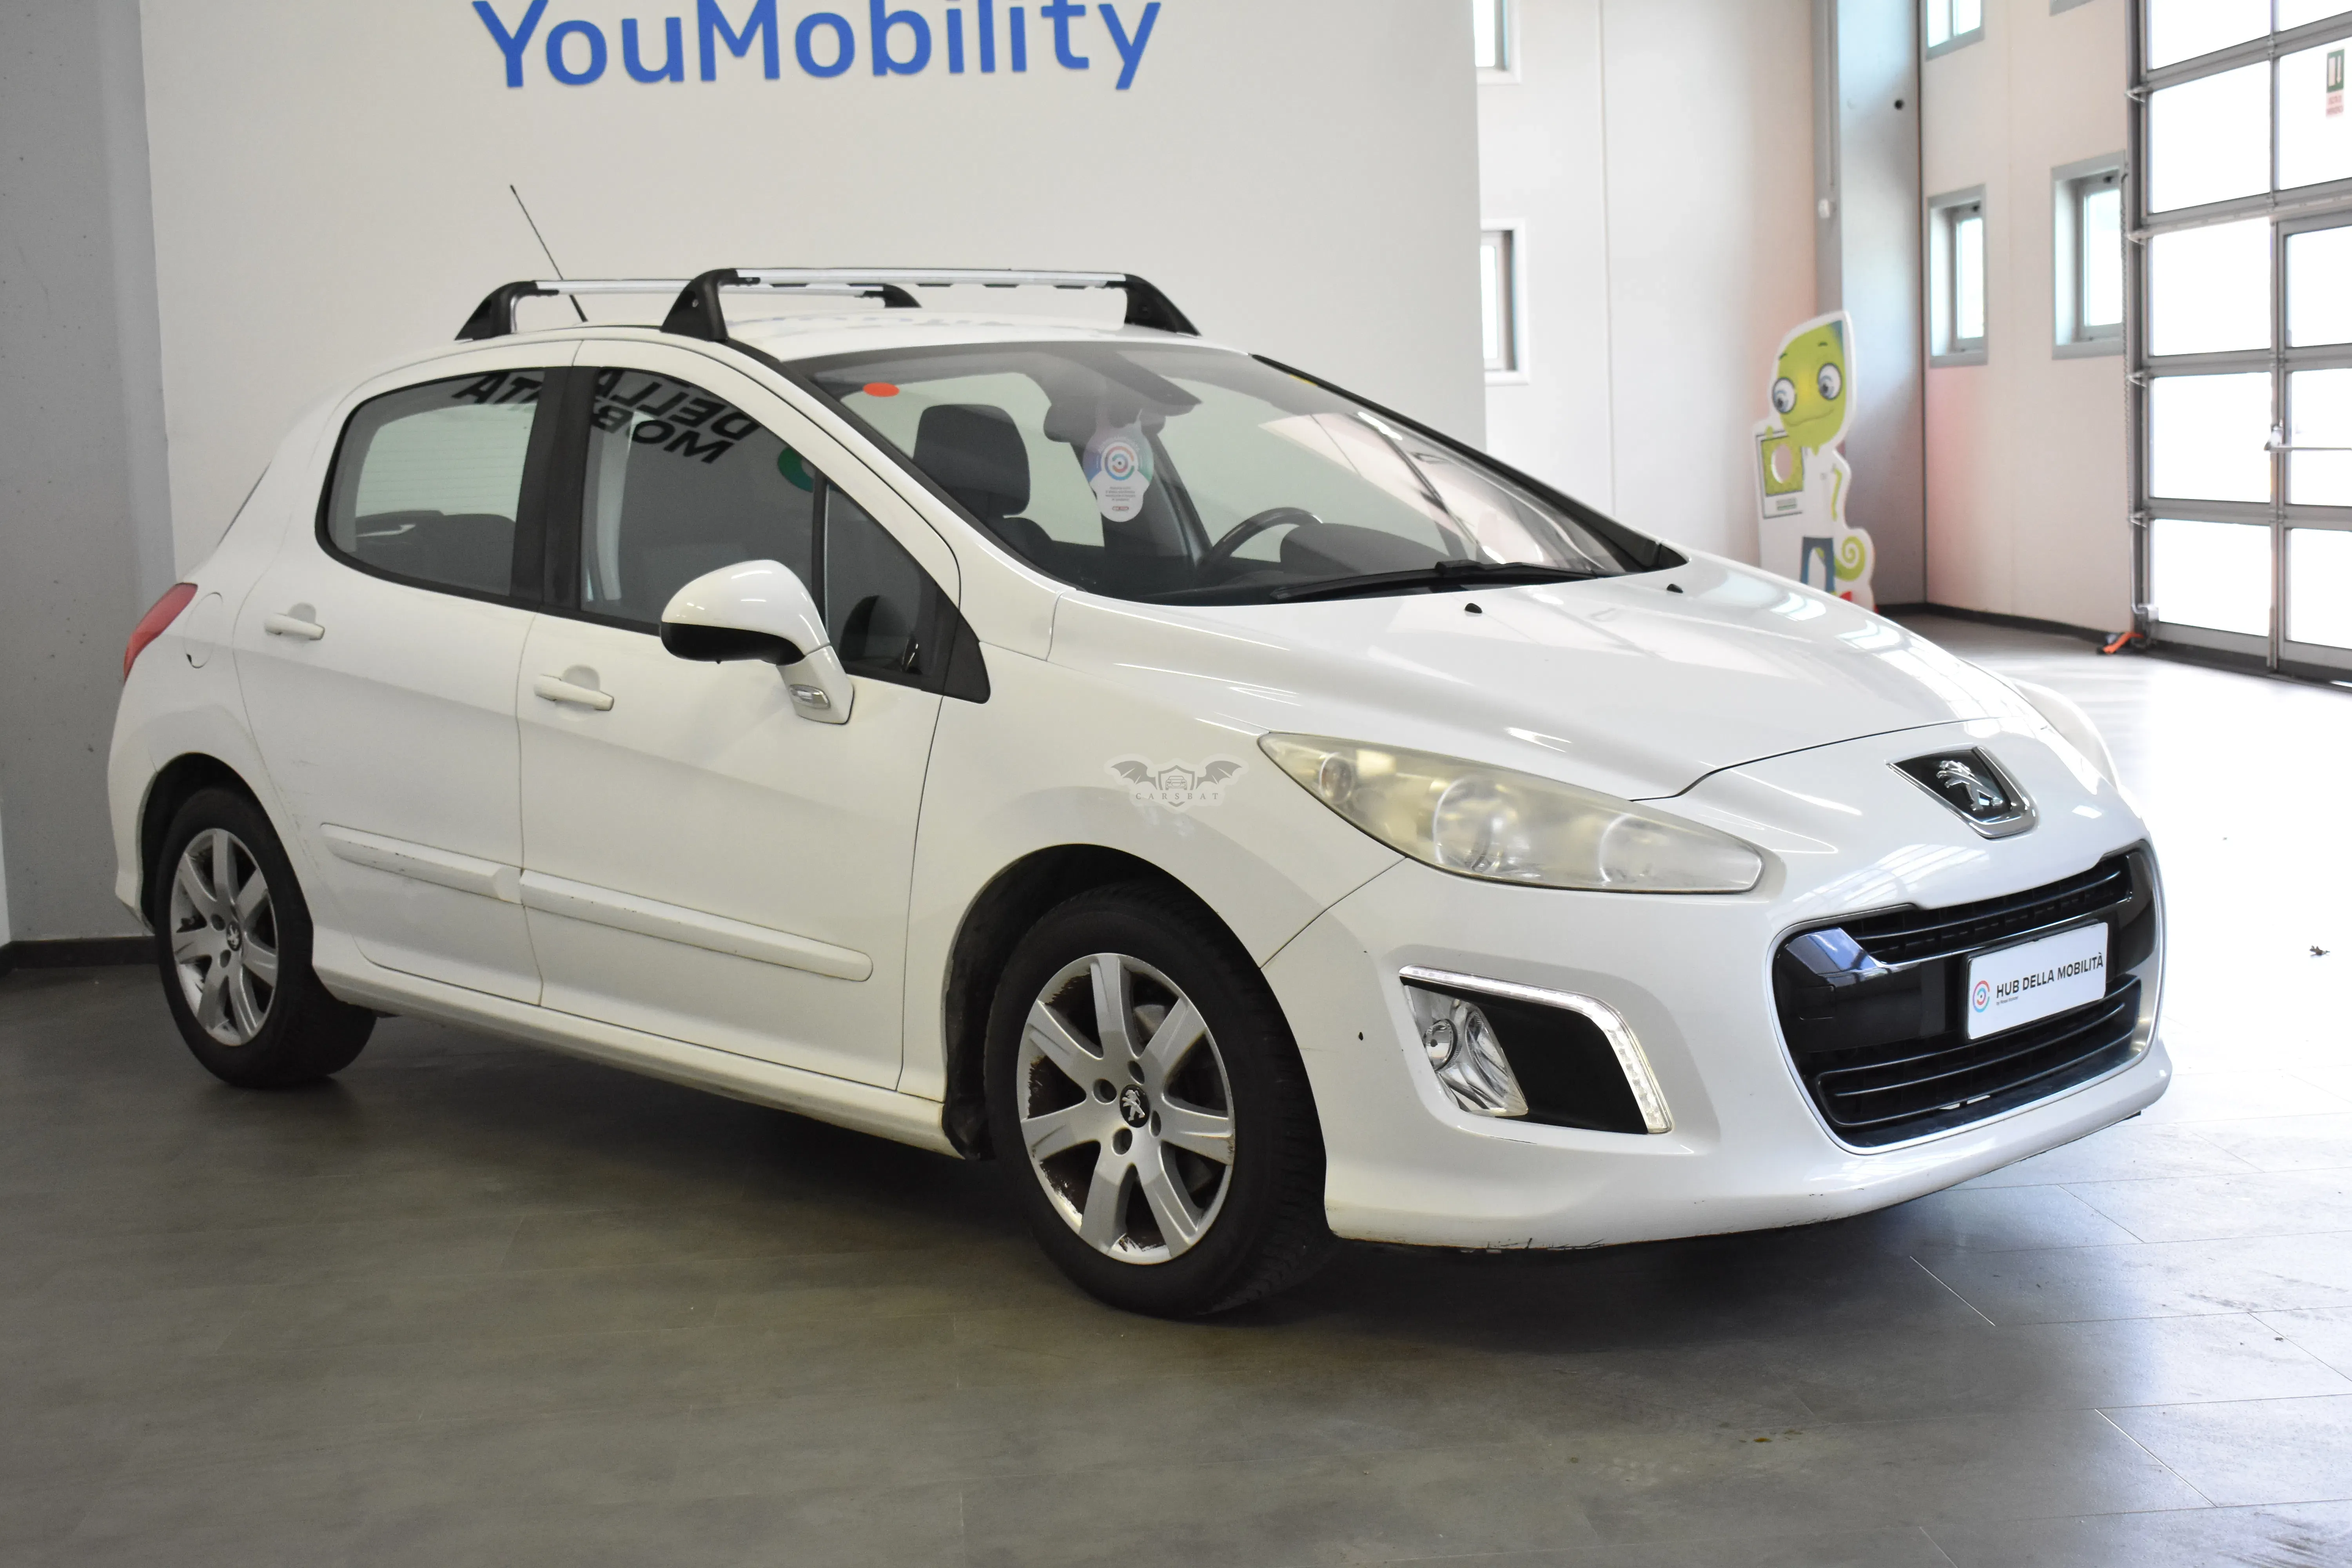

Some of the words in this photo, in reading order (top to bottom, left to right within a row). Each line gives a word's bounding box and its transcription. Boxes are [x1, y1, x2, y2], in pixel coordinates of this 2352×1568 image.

[473, 0, 1161, 90] YouMobility
[1996, 980, 2020, 998] HUB
[2023, 970, 2054, 991] DELLA
[2057, 952, 2103, 980] MOBILITÀ
